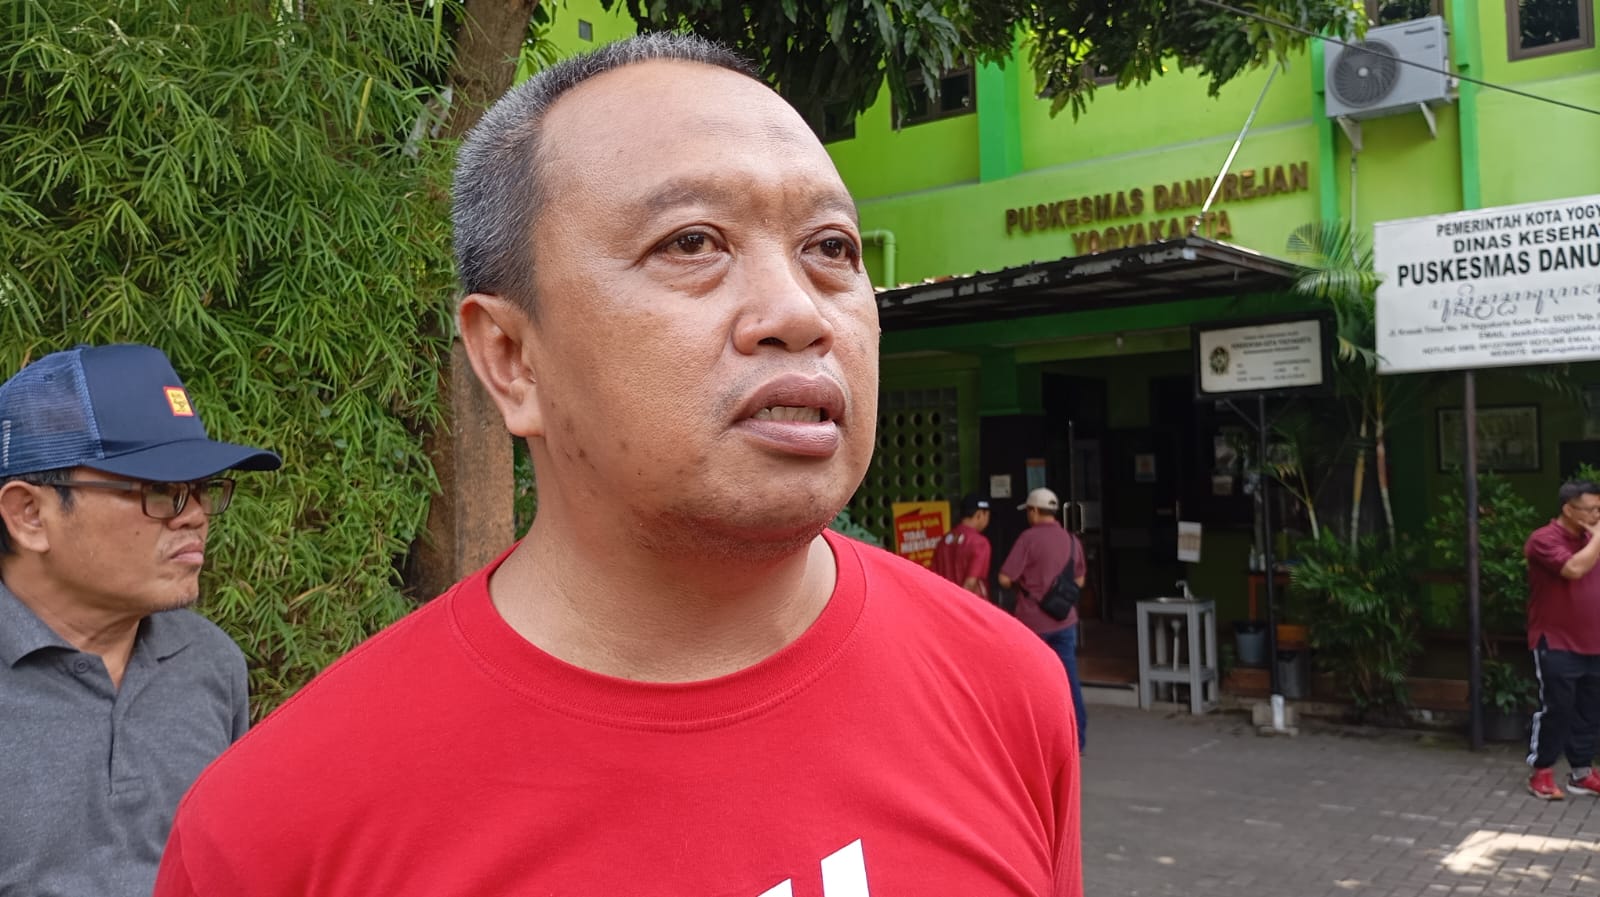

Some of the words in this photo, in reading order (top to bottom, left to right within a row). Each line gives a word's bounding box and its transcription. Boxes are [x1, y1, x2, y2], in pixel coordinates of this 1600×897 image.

[1005, 188, 1144, 236] PUSKESMAS
[1436, 214, 1521, 237] PEMERINTAH
[1525, 209, 1562, 228] KOTA
[1453, 234, 1512, 254] DINAS
[1519, 225, 1600, 246] KESEHA
[1397, 250, 1531, 287] PUSKESMAS
[1539, 244, 1600, 272] DANU
